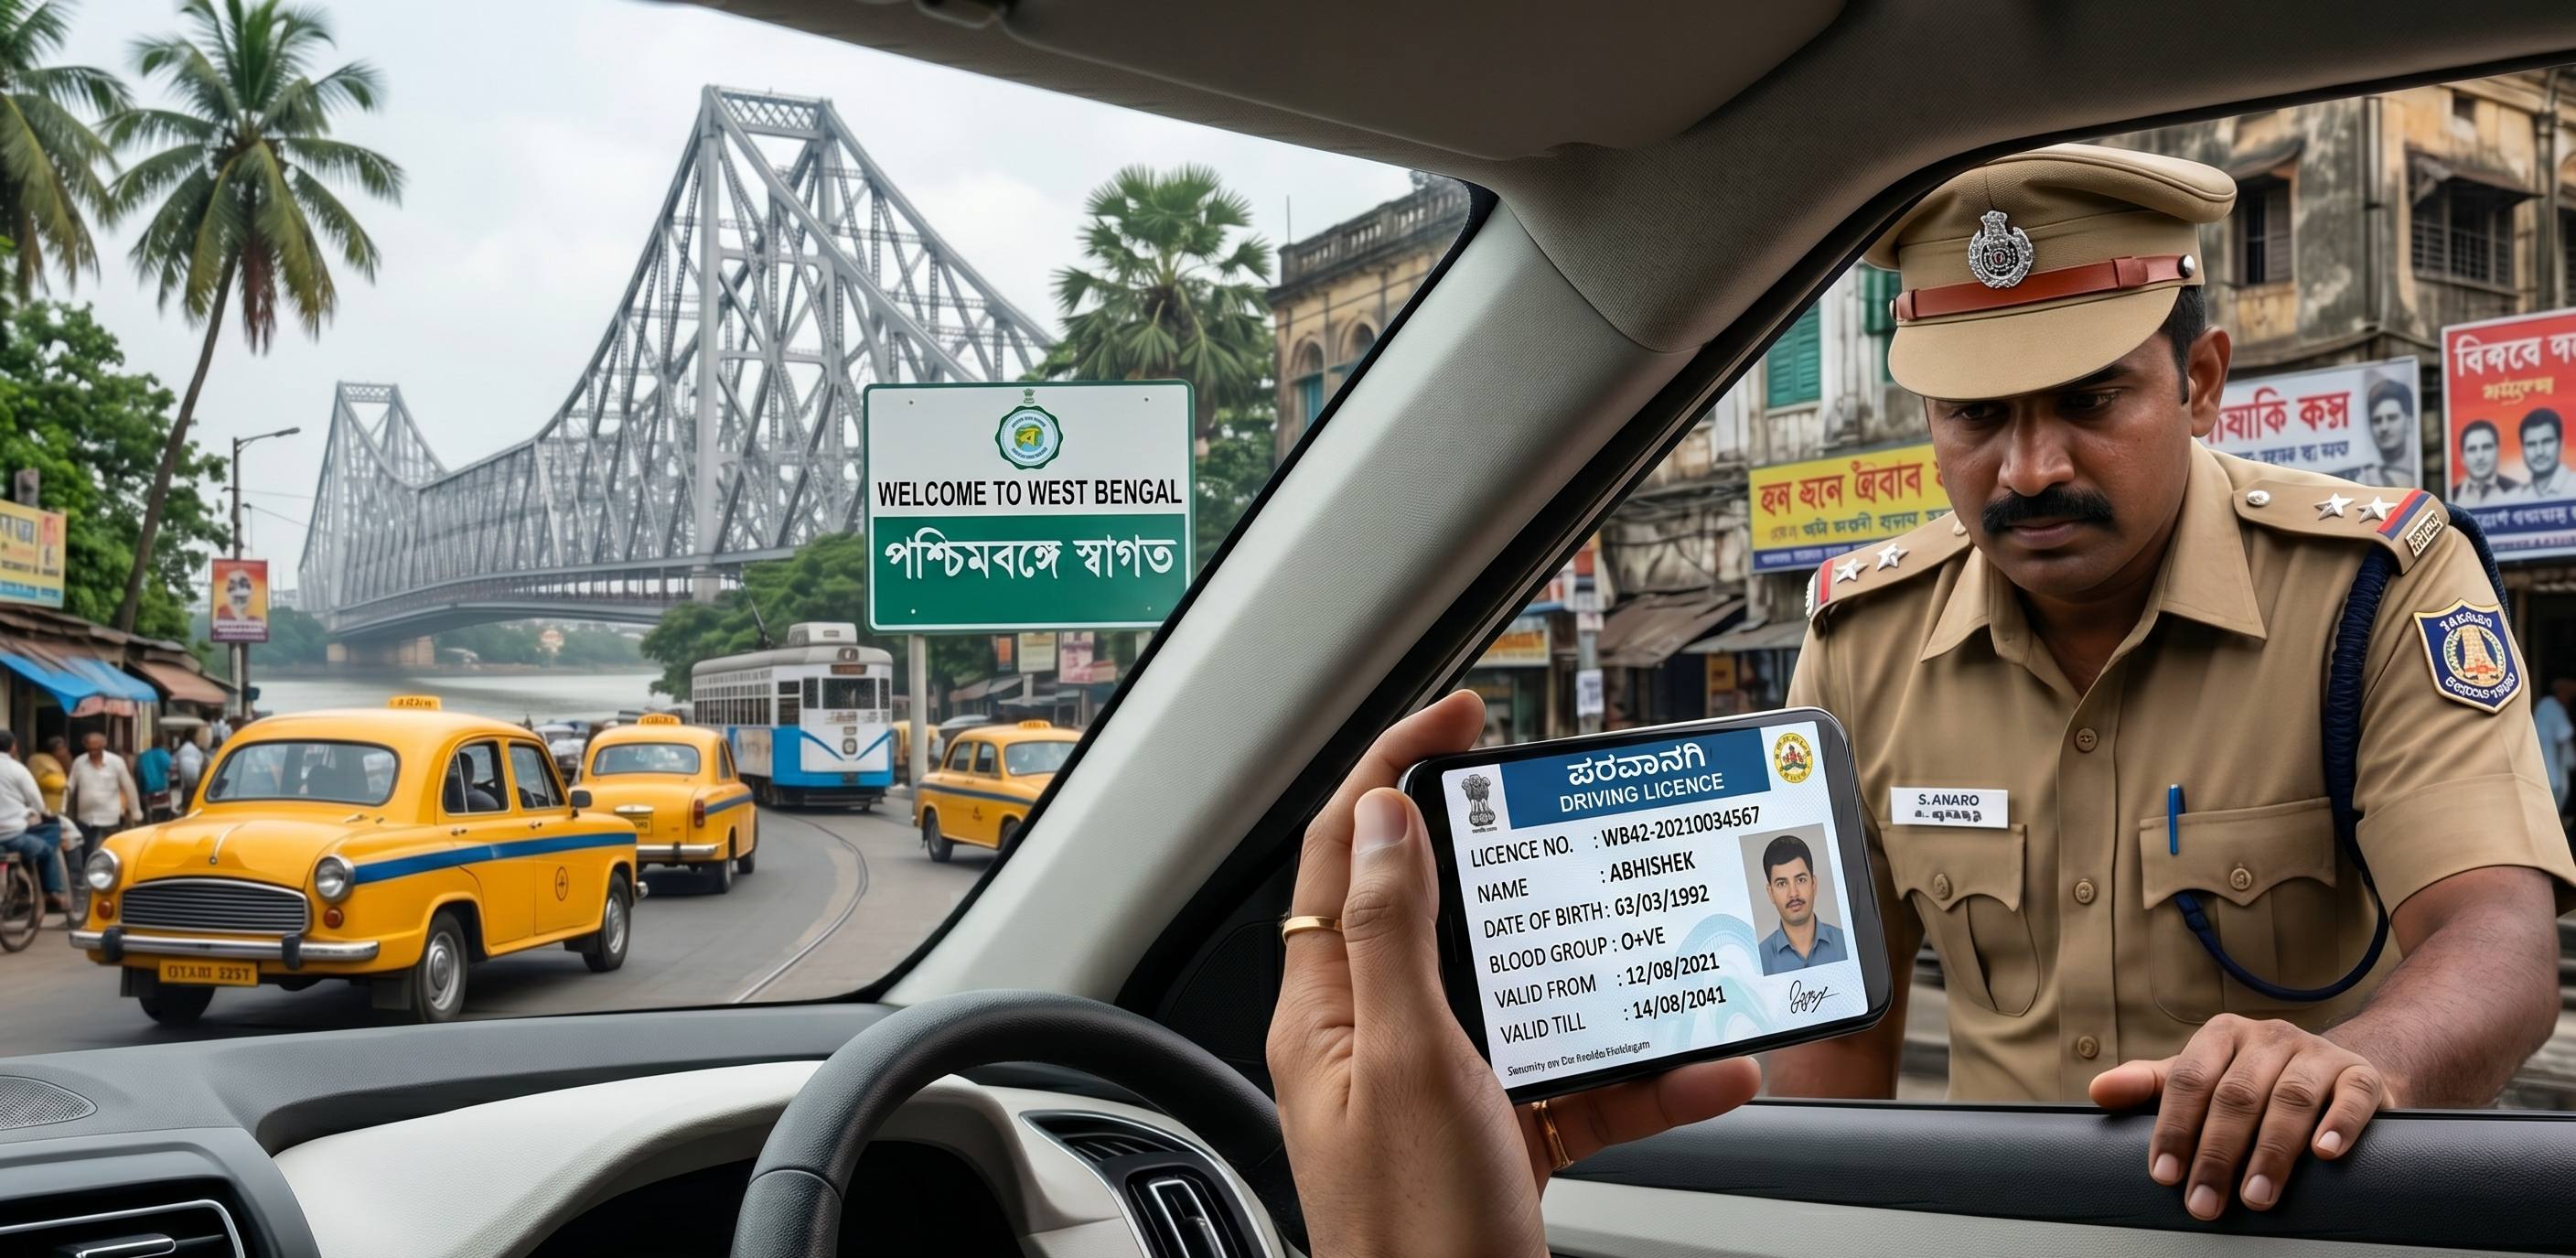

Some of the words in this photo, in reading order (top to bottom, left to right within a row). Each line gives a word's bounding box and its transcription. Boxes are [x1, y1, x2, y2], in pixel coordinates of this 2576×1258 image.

[878, 480, 987, 507] WELCOME
[993, 480, 1022, 506] TO
[1027, 479, 1088, 505] WEST
[1095, 478, 1182, 504] BENGAL
[885, 526, 1063, 579] পশ্চিমবঙ্গে
[1072, 533, 1177, 578] স্বাগত
[1567, 742, 1706, 785] ಪರವಾನಗಿ
[1560, 786, 1638, 812] DRIVING
[1646, 773, 1724, 801] LICENCE
[1470, 840, 1539, 867] LICENCE
[1543, 835, 1573, 856] NO.
[1602, 806, 1760, 847] WB42-20210034567
[1477, 878, 1529, 903] NAME
[1610, 851, 1695, 882] ABHISHEK
[1484, 915, 1526, 939] DATE
[1529, 910, 1551, 930] OF
[1489, 948, 1546, 973] BLOOD
[1551, 937, 1607, 962] GROUP
[1621, 927, 1666, 951] O+VE
[1494, 984, 1542, 1008] VALID
[1547, 973, 1596, 999] FROM
[1626, 952, 1720, 985] 12/08/2021
[1500, 1020, 1549, 1045] VALID
[1551, 1012, 1586, 1034] TILL
[1633, 985, 1726, 1019] 14/08/2041
